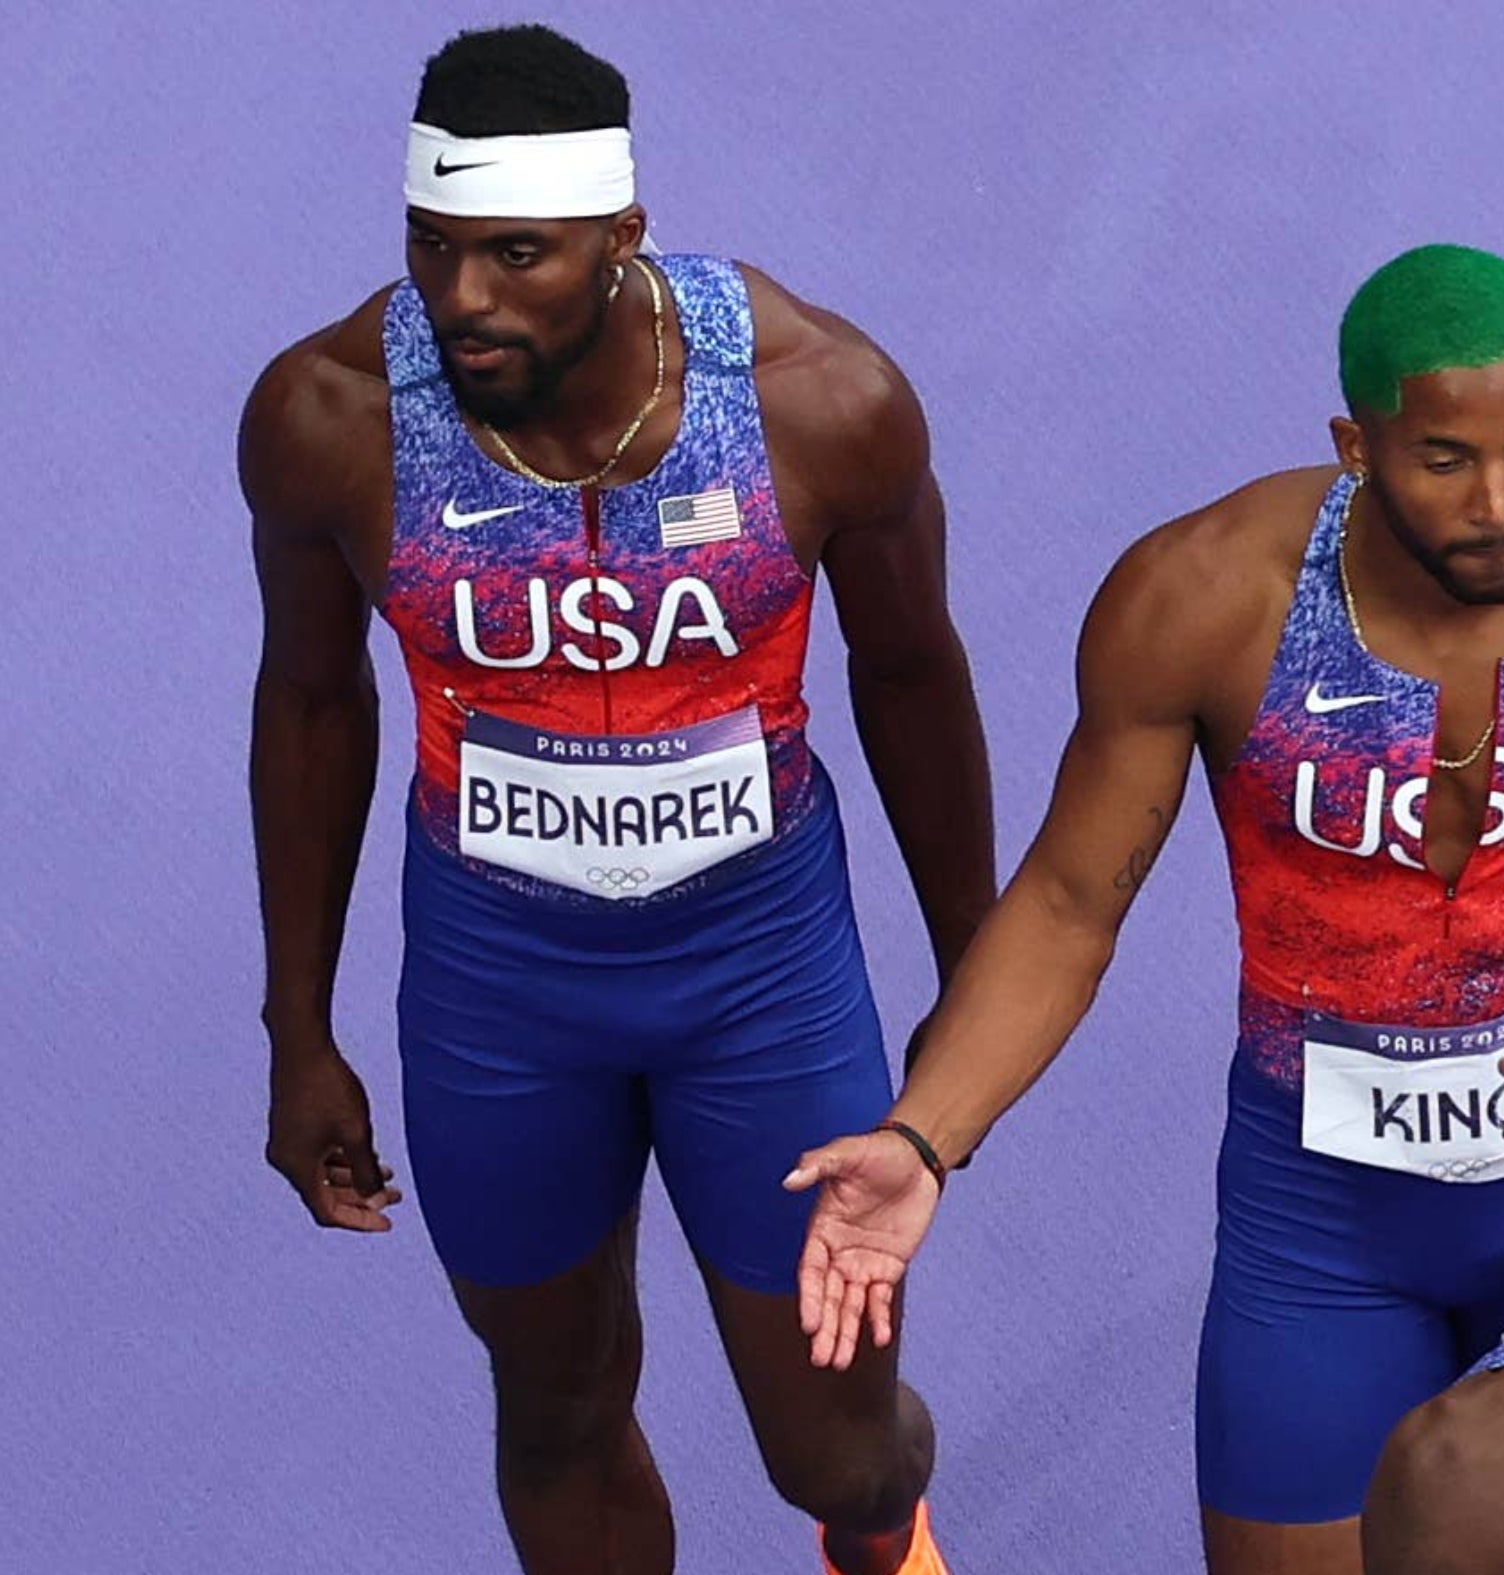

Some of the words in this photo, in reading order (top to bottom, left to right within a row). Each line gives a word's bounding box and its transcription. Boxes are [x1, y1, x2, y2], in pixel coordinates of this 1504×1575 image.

[454, 577, 740, 671] USA
[536, 736, 611, 757] PARIS
[619, 738, 687, 758] 2024
[467, 776, 760, 846] BEDNAREK
[1378, 1033, 1453, 1053] PARIS
